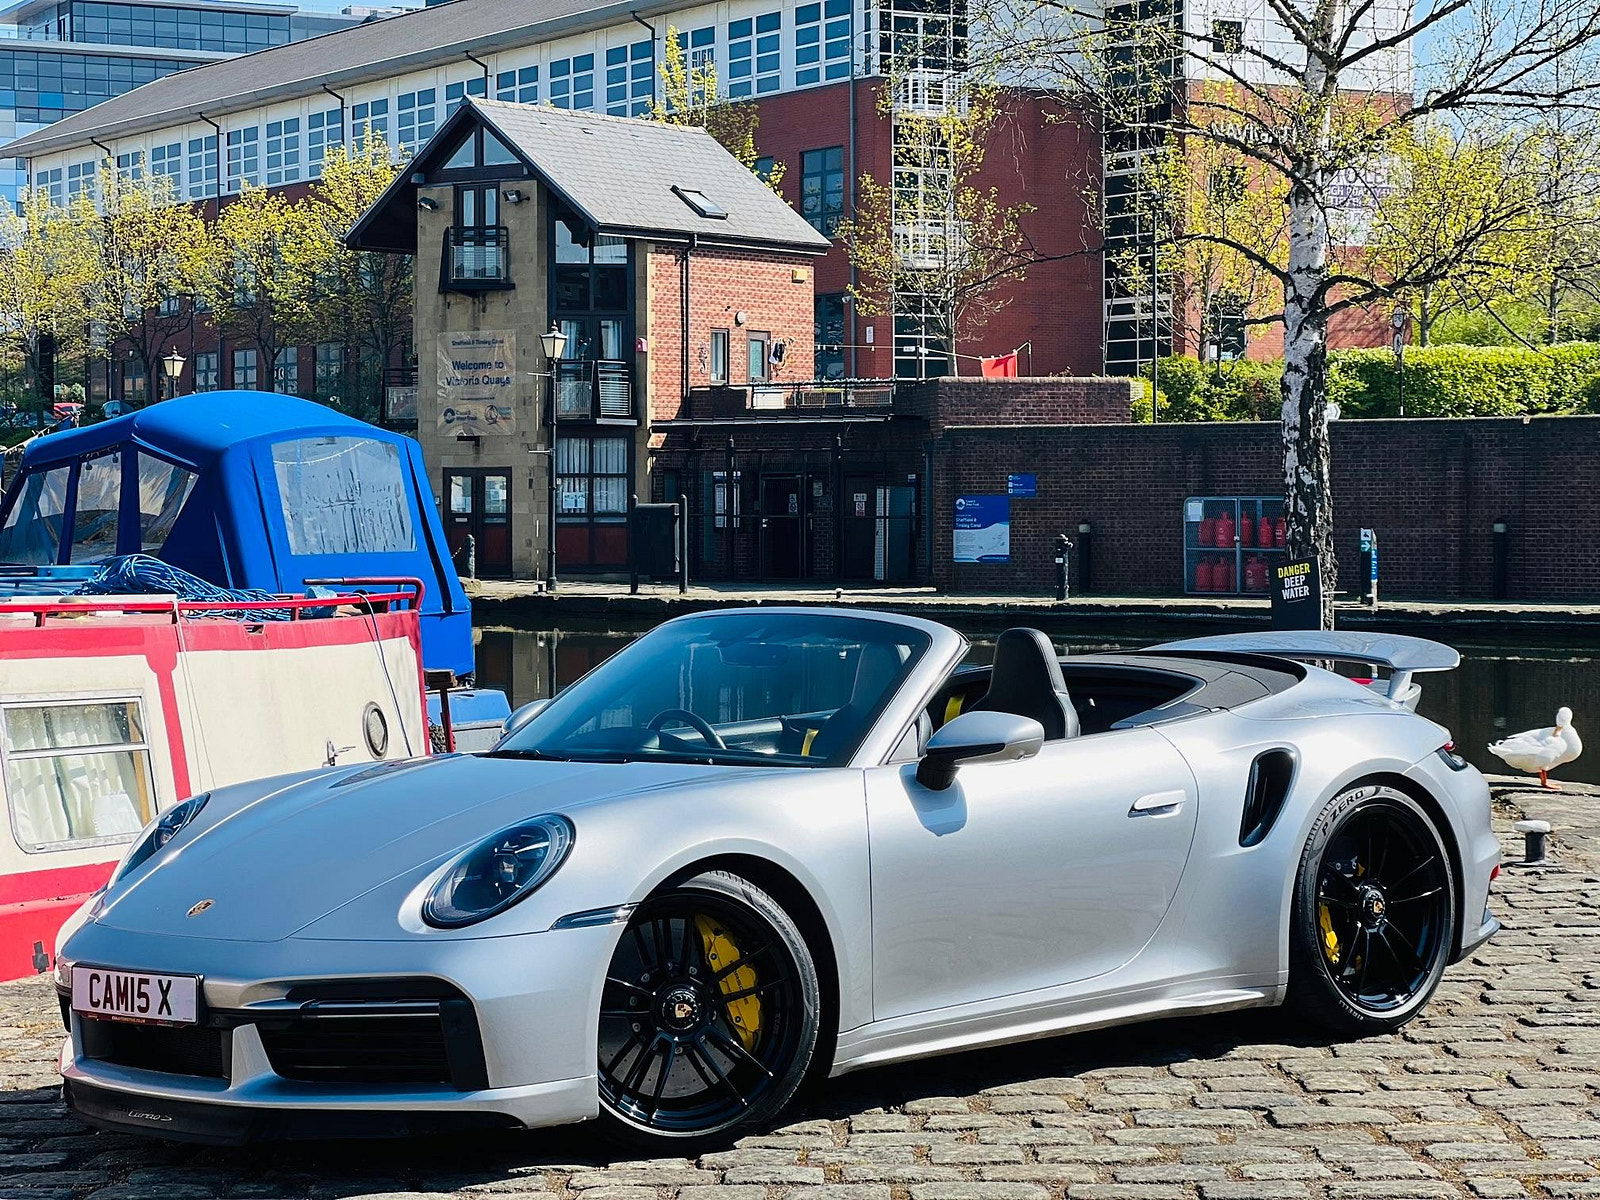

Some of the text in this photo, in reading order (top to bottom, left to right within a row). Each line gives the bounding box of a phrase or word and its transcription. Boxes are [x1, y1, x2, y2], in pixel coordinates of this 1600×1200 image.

[452, 360, 504, 371] Welcome to
[445, 375, 511, 388] Victoria Quays
[1277, 562, 1311, 579] DANGER
[1284, 575, 1306, 588] DEEP
[1281, 586, 1310, 600] WATER
[1321, 789, 1364, 837] P ZERO
[157, 979, 173, 1016] X
[1338, 999, 1364, 1021] PIRELLI
